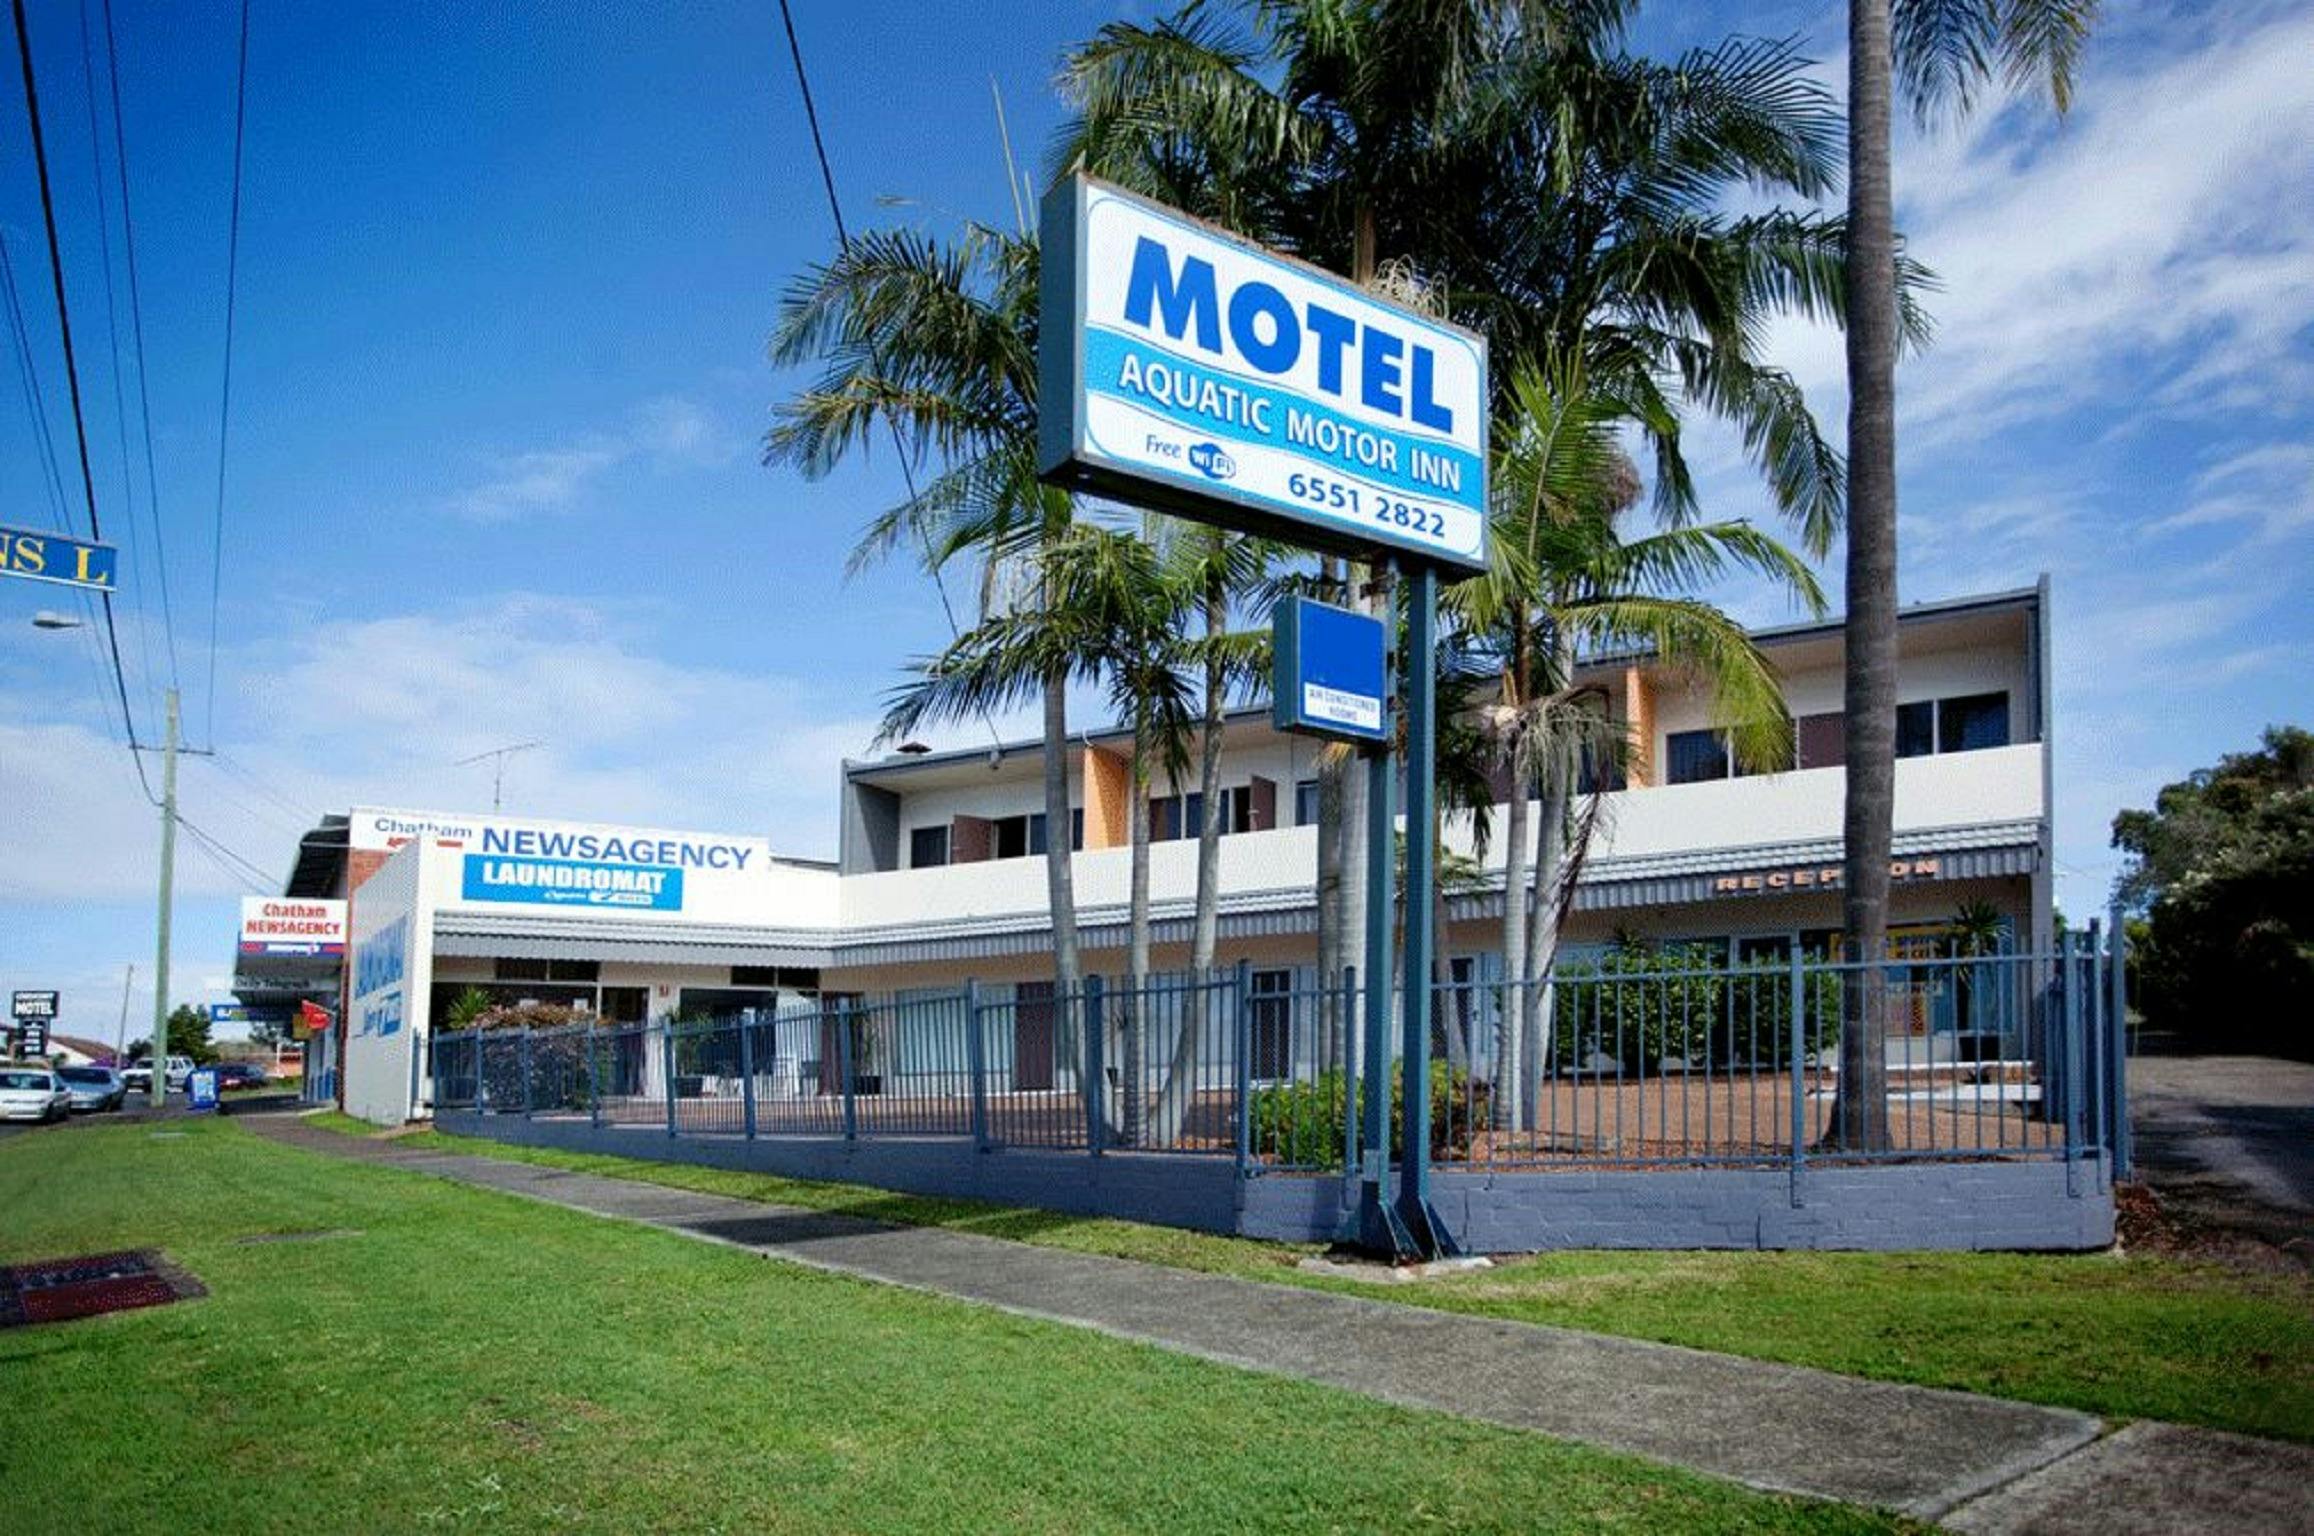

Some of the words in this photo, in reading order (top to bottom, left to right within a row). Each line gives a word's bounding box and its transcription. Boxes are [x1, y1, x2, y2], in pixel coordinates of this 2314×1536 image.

[1123, 234, 1453, 435] MOTEL
[1118, 353, 1272, 435] AQUATIC
[1287, 410, 1399, 474] MOTOR
[1410, 446, 1461, 493] INN
[1145, 433, 1182, 459] Free
[1288, 472, 1360, 513] 6551
[1375, 496, 1446, 539] 2822
[374, 817, 473, 840] Chatham
[482, 827, 753, 871] NEWSAGENCY
[482, 860, 667, 895] LAUNDROMAT
[1716, 859, 1941, 891] RECEPON
[262, 902, 327, 918] Chatham
[245, 920, 341, 936] NEWSAGENCY
